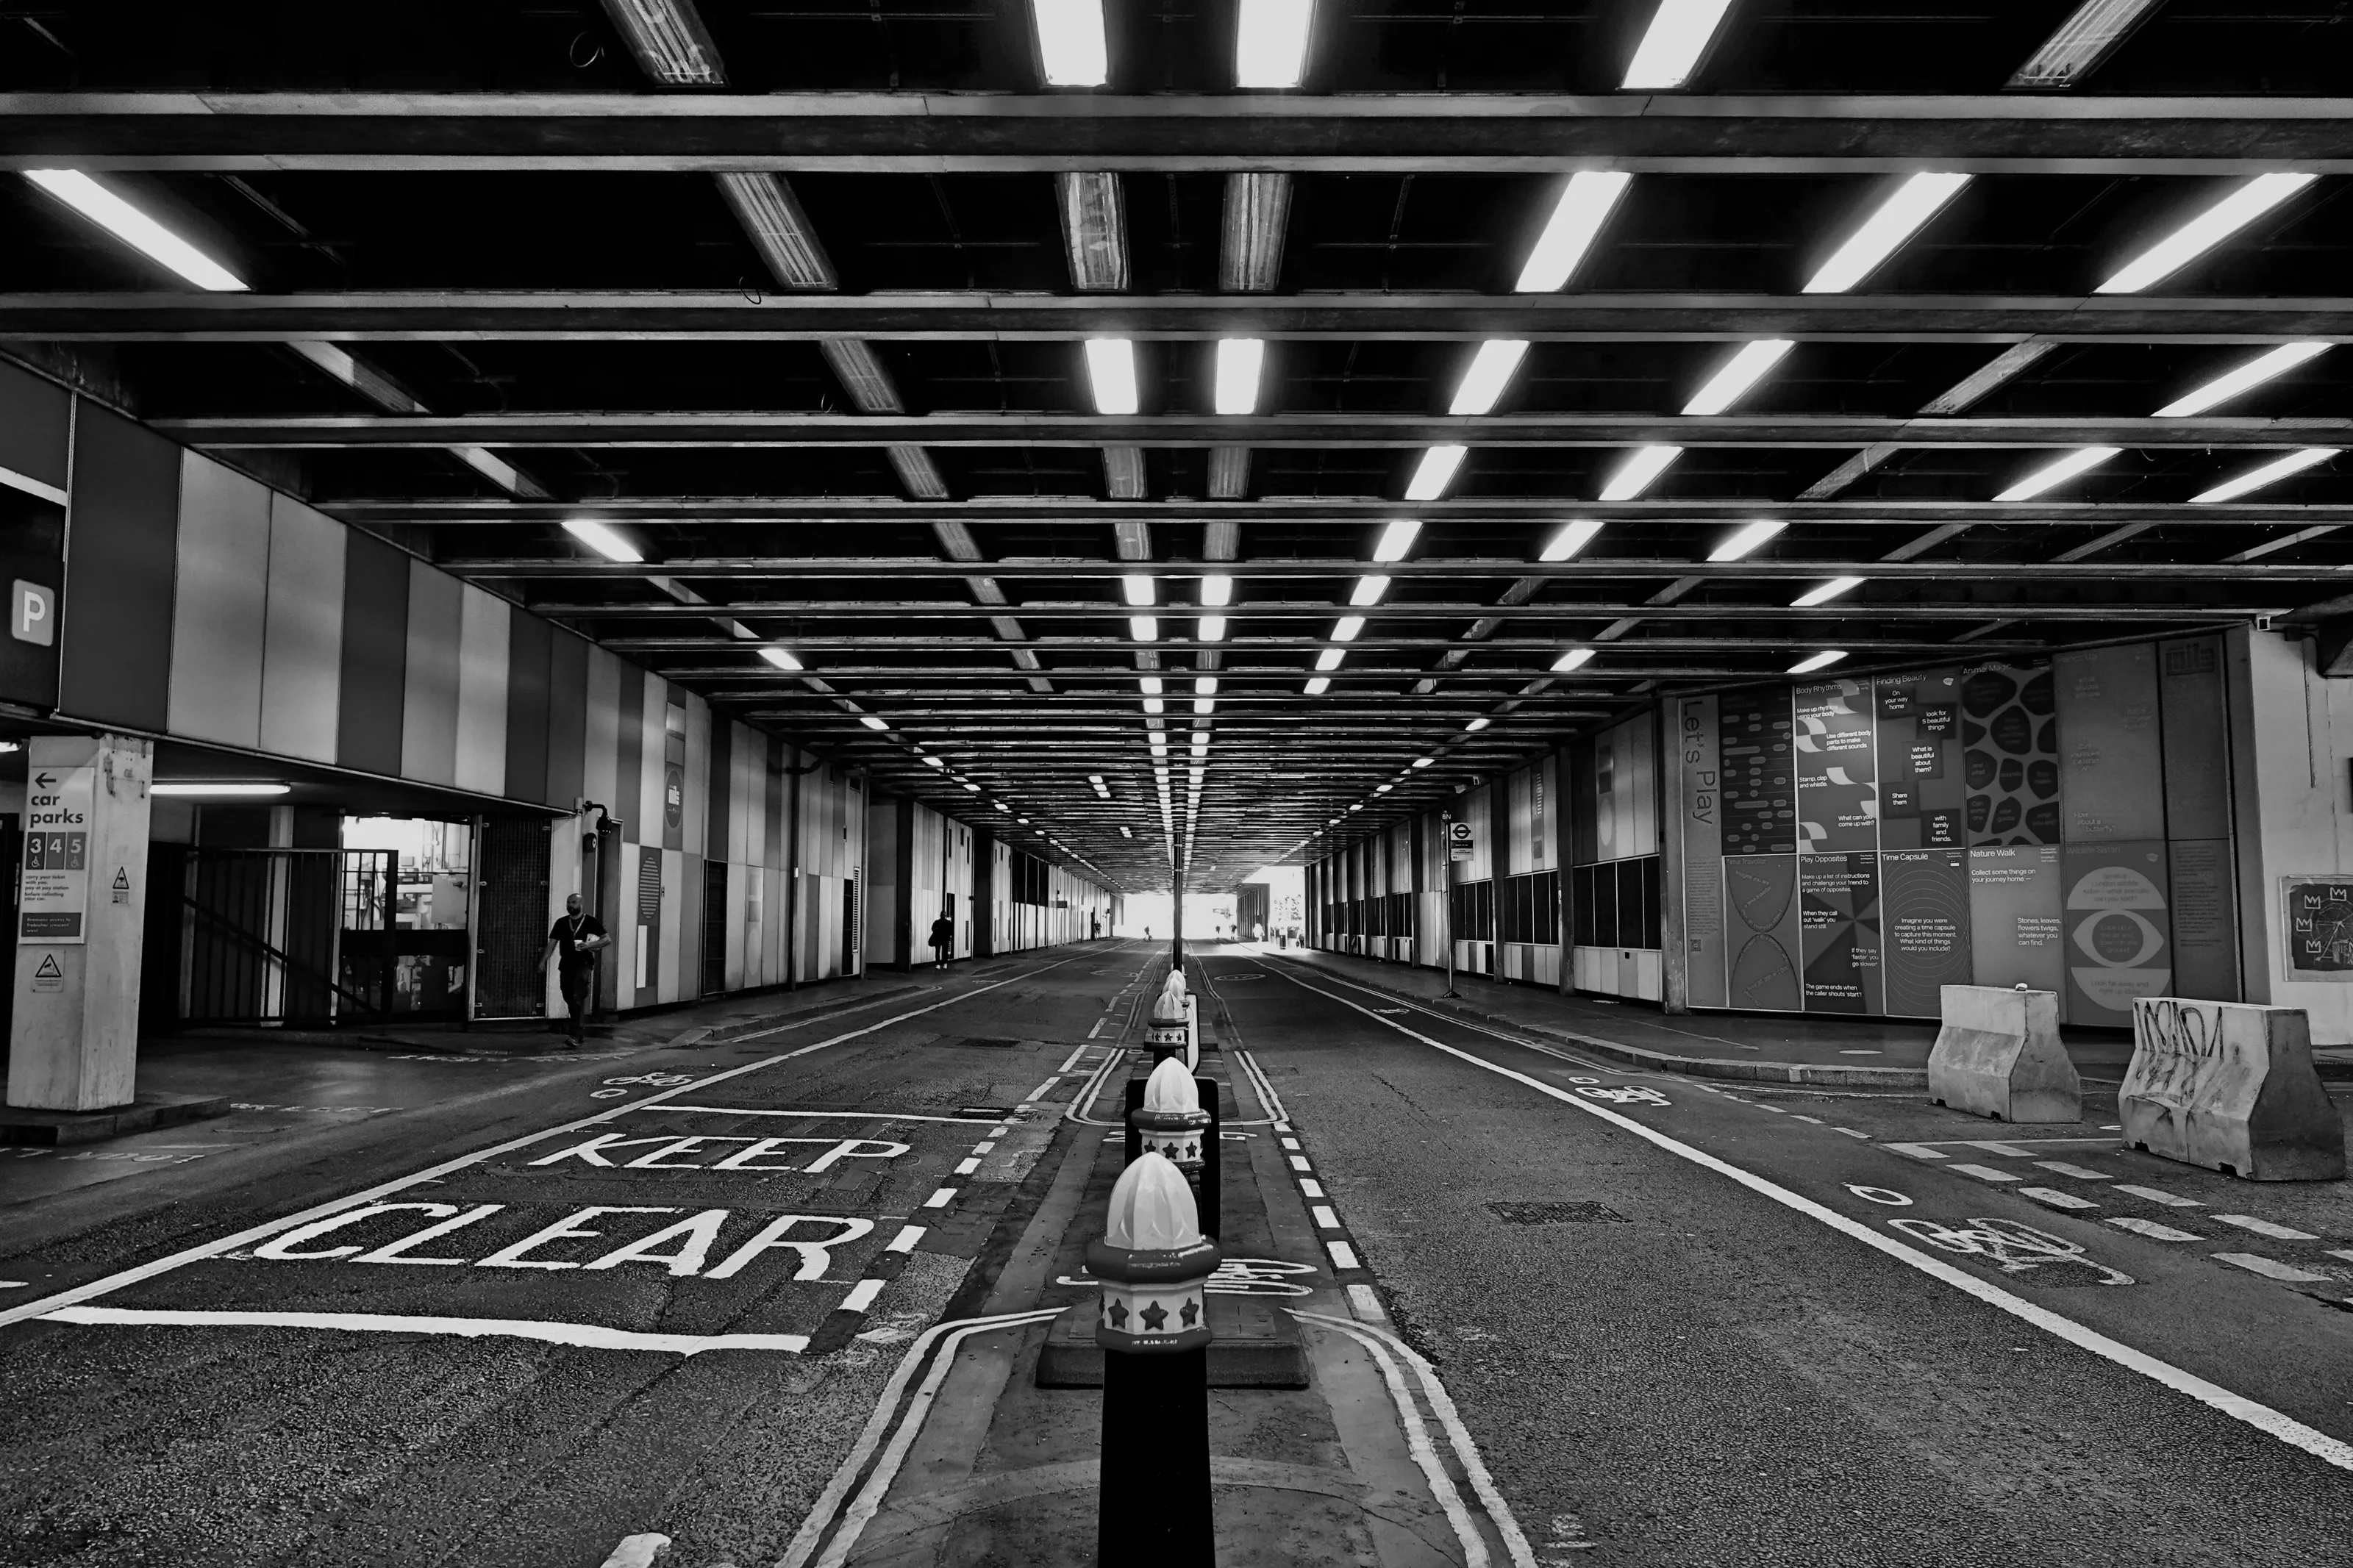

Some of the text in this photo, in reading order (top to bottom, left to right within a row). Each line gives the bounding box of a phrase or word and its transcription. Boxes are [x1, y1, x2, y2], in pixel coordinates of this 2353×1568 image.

[24, 590, 46, 633] P
[1877, 676, 1901, 686] Finding
[1902, 674, 1927, 684] Beauty
[1796, 683, 1842, 695] Body Rhythms
[1818, 704, 1838, 712] rhythms
[1797, 712, 1810, 720] using
[1822, 710, 1835, 718] body
[1858, 729, 1872, 737] body
[1685, 701, 1717, 824] Let's Play
[31, 795, 60, 806] car
[30, 808, 83, 828] parks
[30, 838, 82, 853] 3 4 5
[1970, 850, 1995, 858] Nature
[1997, 849, 2015, 857] Walk
[1801, 856, 1813, 864] Play
[1815, 856, 1847, 864] Opposites
[528, 1132, 910, 1173] KEEP
[253, 1202, 875, 1281] CLEAR
